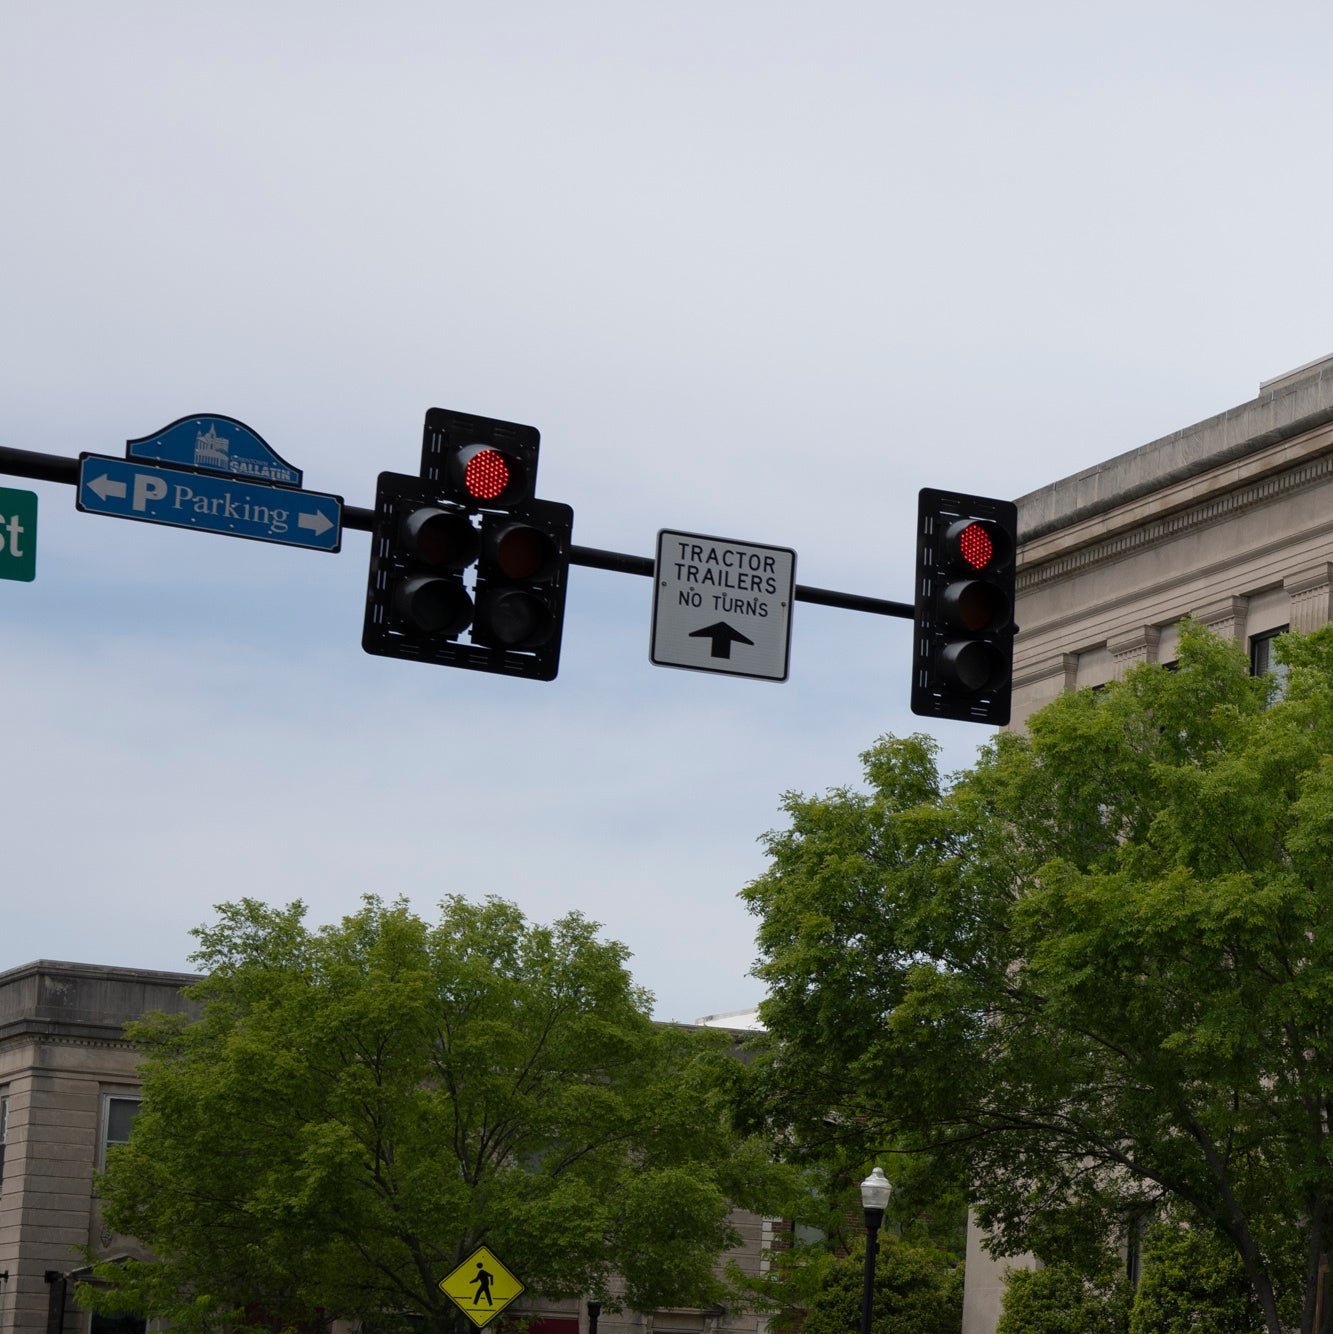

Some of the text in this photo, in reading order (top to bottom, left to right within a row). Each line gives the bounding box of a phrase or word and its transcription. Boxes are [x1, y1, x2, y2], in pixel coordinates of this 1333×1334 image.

[131, 473, 290, 534] P Parking
[0, 513, 24, 557] t
[678, 542, 776, 575] TRACTOR
[674, 562, 777, 595] TRAILERS
[679, 590, 769, 618] NO TURNS
